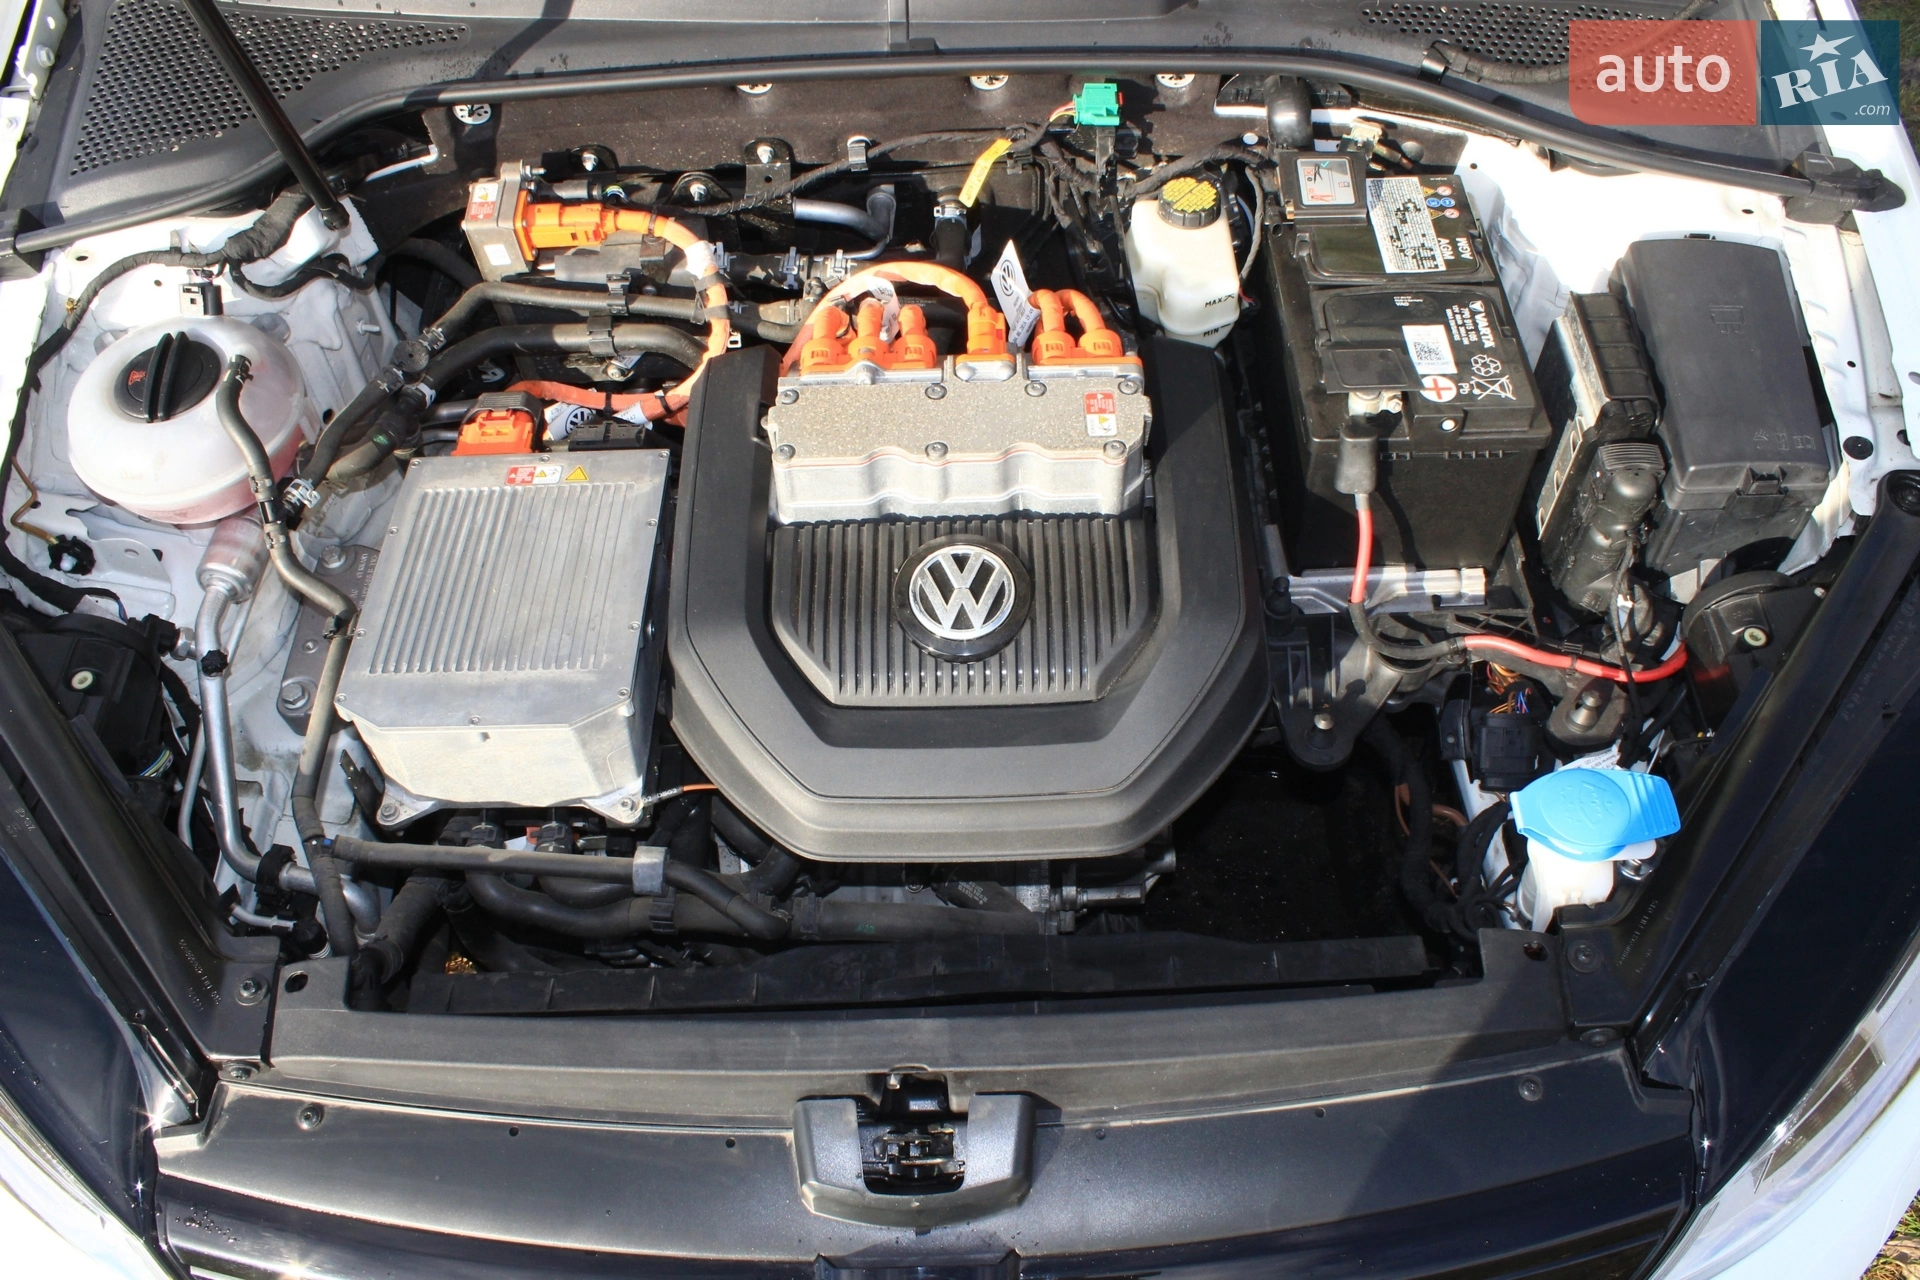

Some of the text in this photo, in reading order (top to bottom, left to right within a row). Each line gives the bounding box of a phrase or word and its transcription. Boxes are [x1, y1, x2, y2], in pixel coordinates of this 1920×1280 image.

[1437, 237, 1455, 259] AGM
[1455, 237, 1474, 260] AGM
[1204, 297, 1223, 308] MAX
[1203, 327, 1220, 338] MIN
[1475, 313, 1495, 348] VARTA
[1458, 382, 1471, 395] Pb
